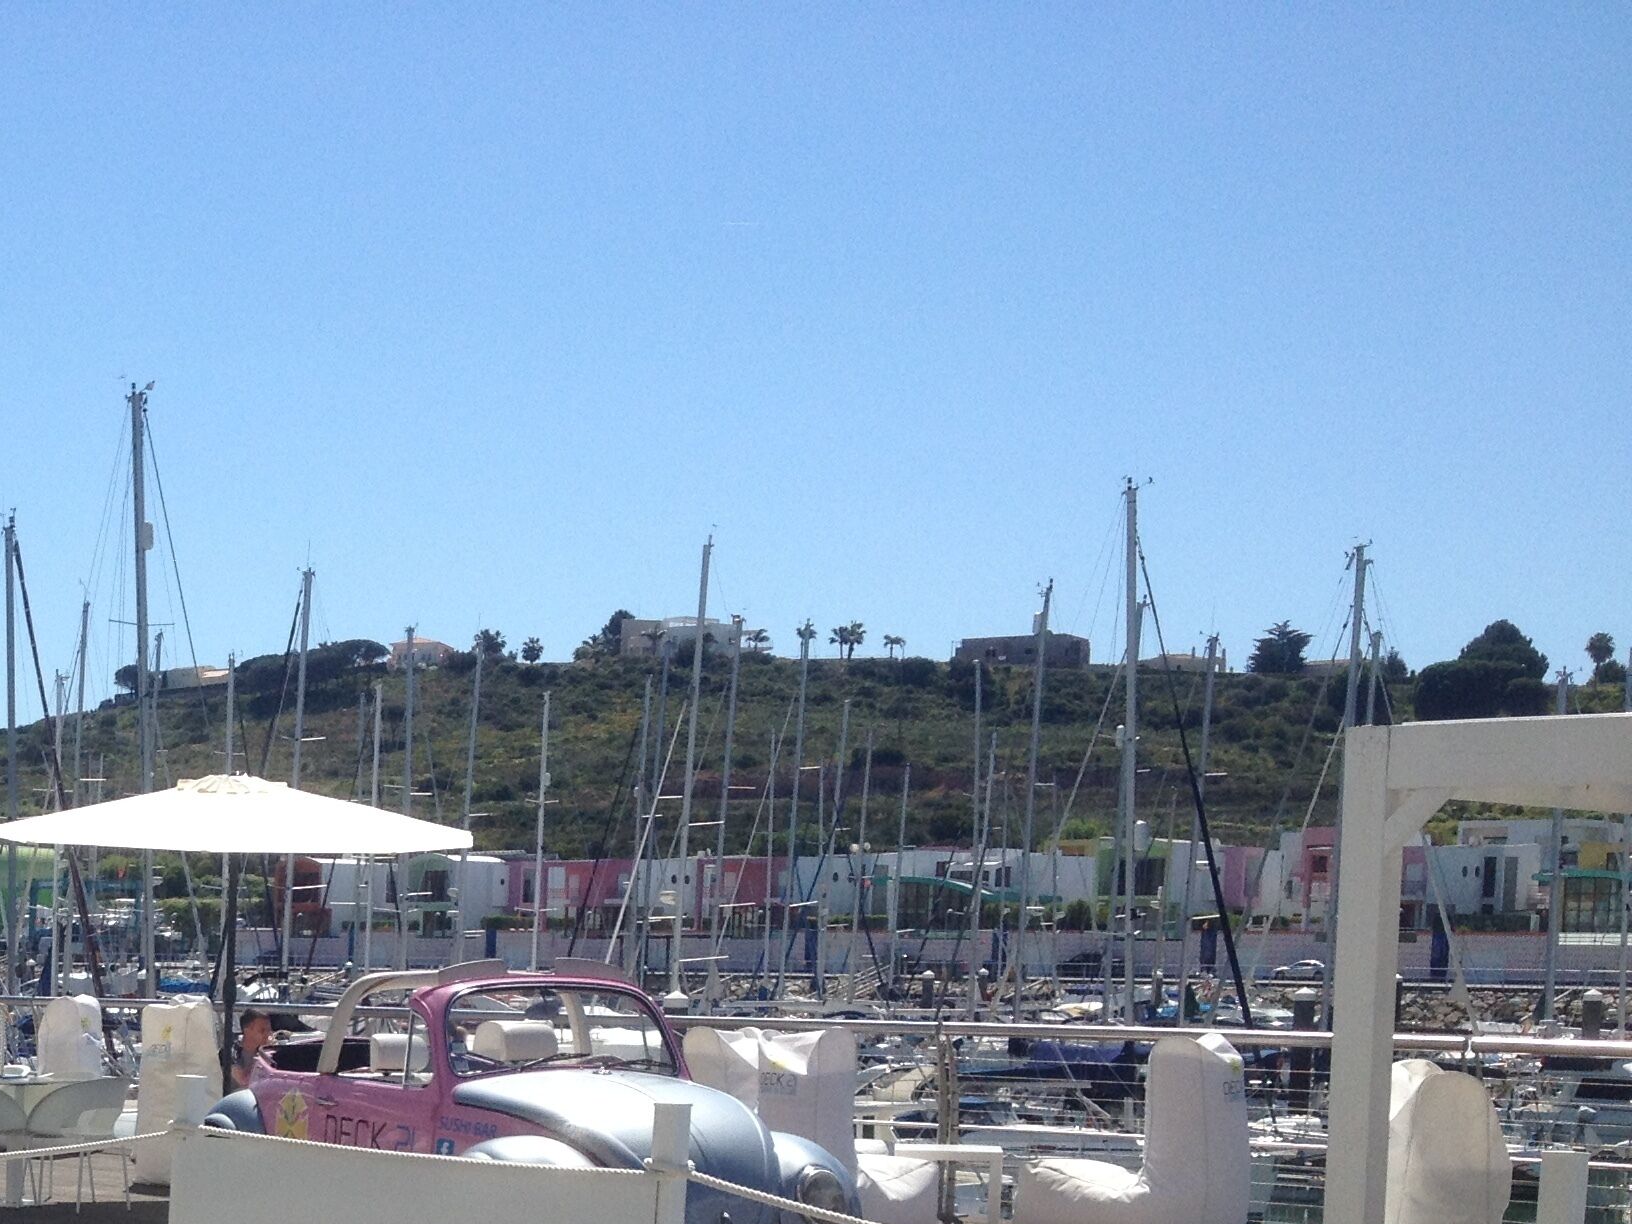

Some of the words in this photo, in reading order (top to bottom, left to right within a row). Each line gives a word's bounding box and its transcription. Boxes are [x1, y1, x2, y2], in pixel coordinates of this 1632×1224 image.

[323, 1114, 387, 1150] DECK
[438, 1116, 472, 1134] SUSHI
[473, 1121, 499, 1139] BAR
